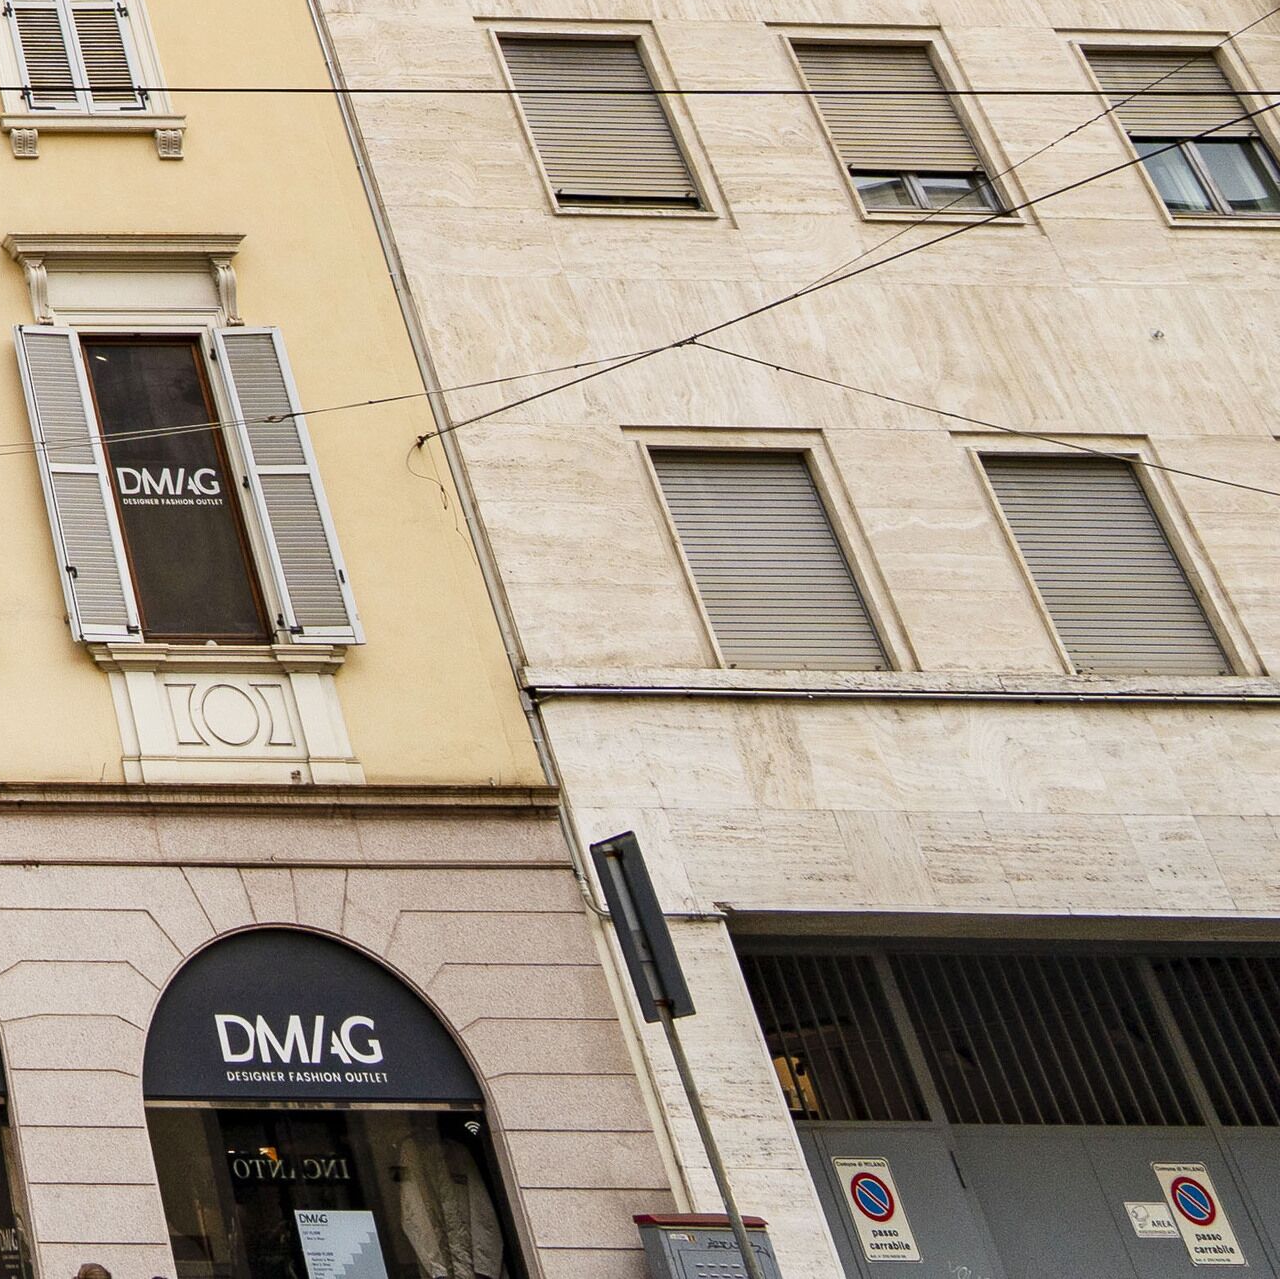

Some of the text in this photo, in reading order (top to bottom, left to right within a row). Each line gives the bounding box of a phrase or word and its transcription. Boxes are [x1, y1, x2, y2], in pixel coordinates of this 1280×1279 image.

[116, 466, 221, 496] DMAG
[123, 498, 224, 506] DESIGNER FASHION OUTLET
[214, 1014, 384, 1064] DMAG
[226, 1070, 388, 1084] DESIGNER FASHION OUTLET
[871, 1229, 899, 1238] passo
[1195, 1233, 1222, 1242] passo
[870, 1242, 911, 1251] carrabile
[1194, 1245, 1236, 1254] carrabile
